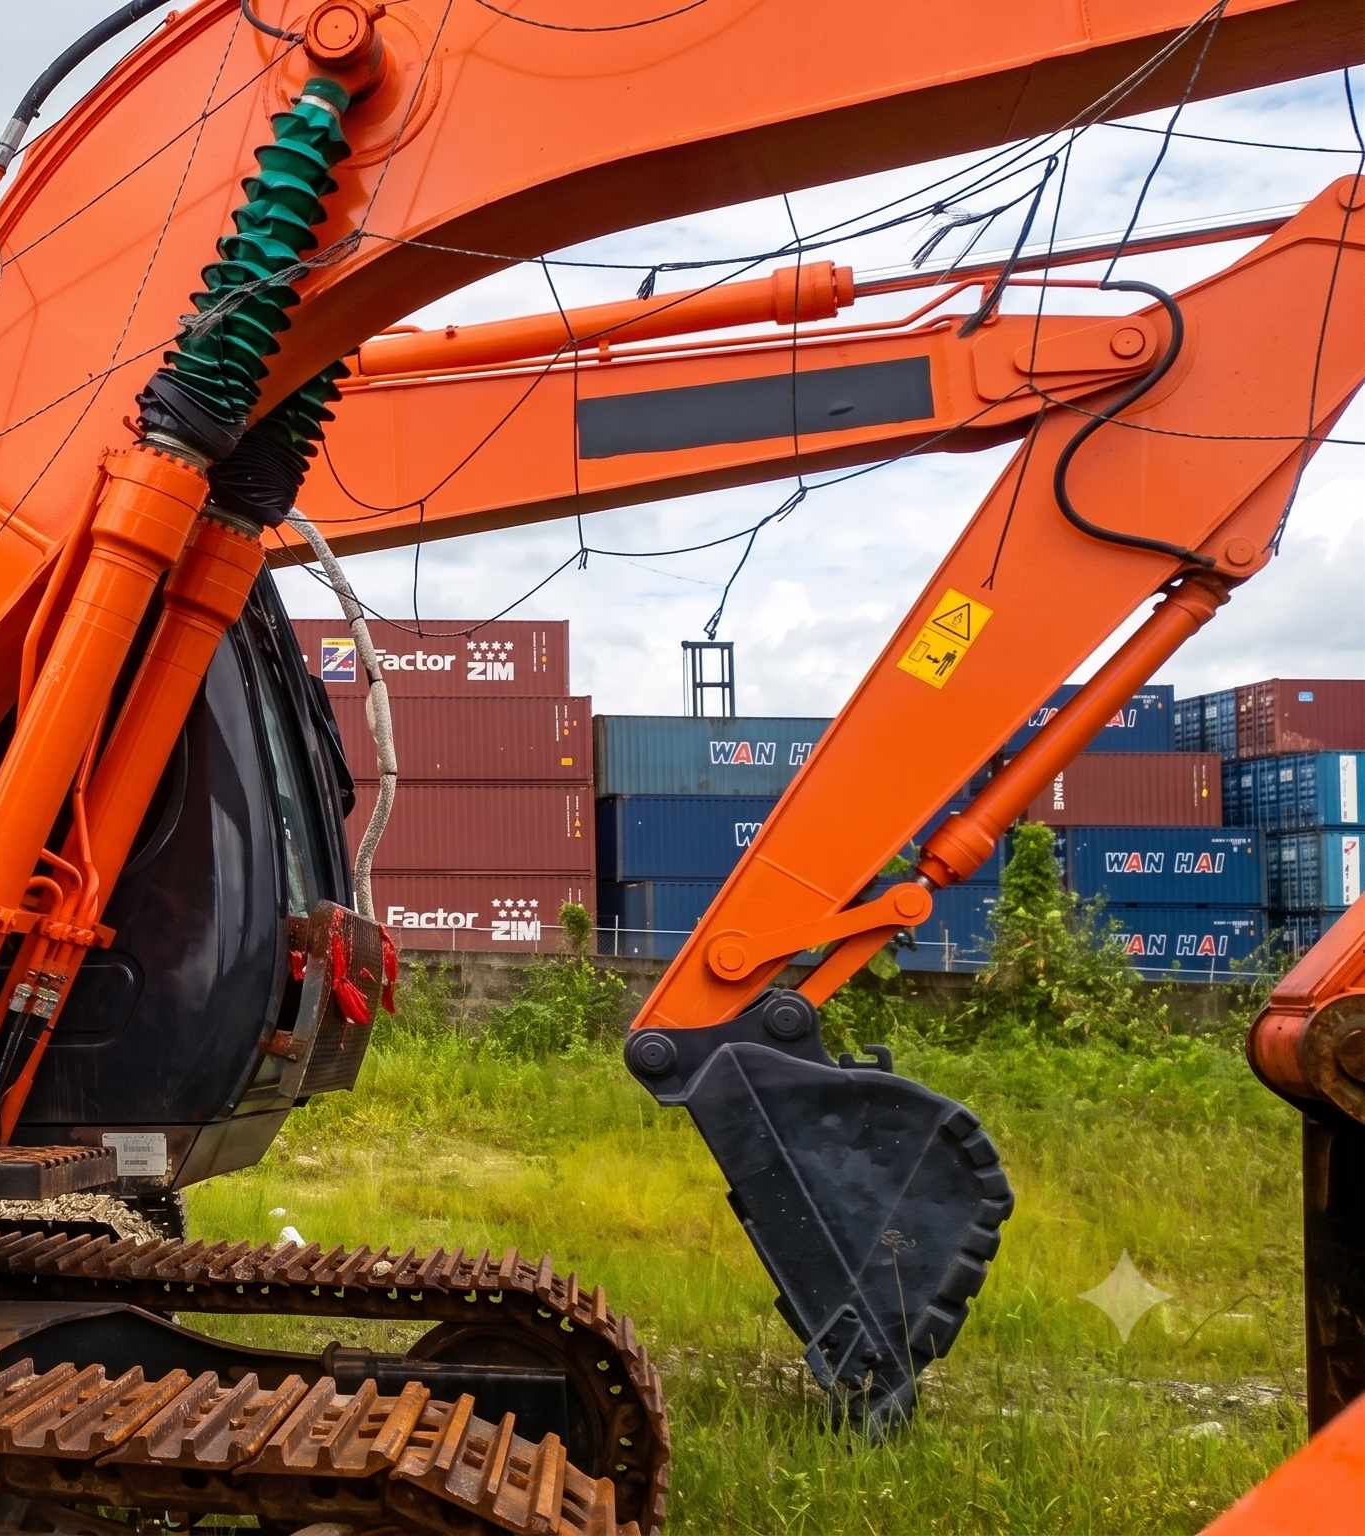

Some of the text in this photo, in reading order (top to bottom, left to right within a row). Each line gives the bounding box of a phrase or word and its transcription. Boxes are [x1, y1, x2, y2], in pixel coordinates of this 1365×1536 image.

[467, 662, 515, 681] ZIM
[710, 741, 776, 765] WAN
[1105, 852, 1225, 873] WAN HAI
[387, 906, 479, 929] Factor
[491, 920, 541, 941] ZIM
[1176, 934, 1228, 956] HAI
